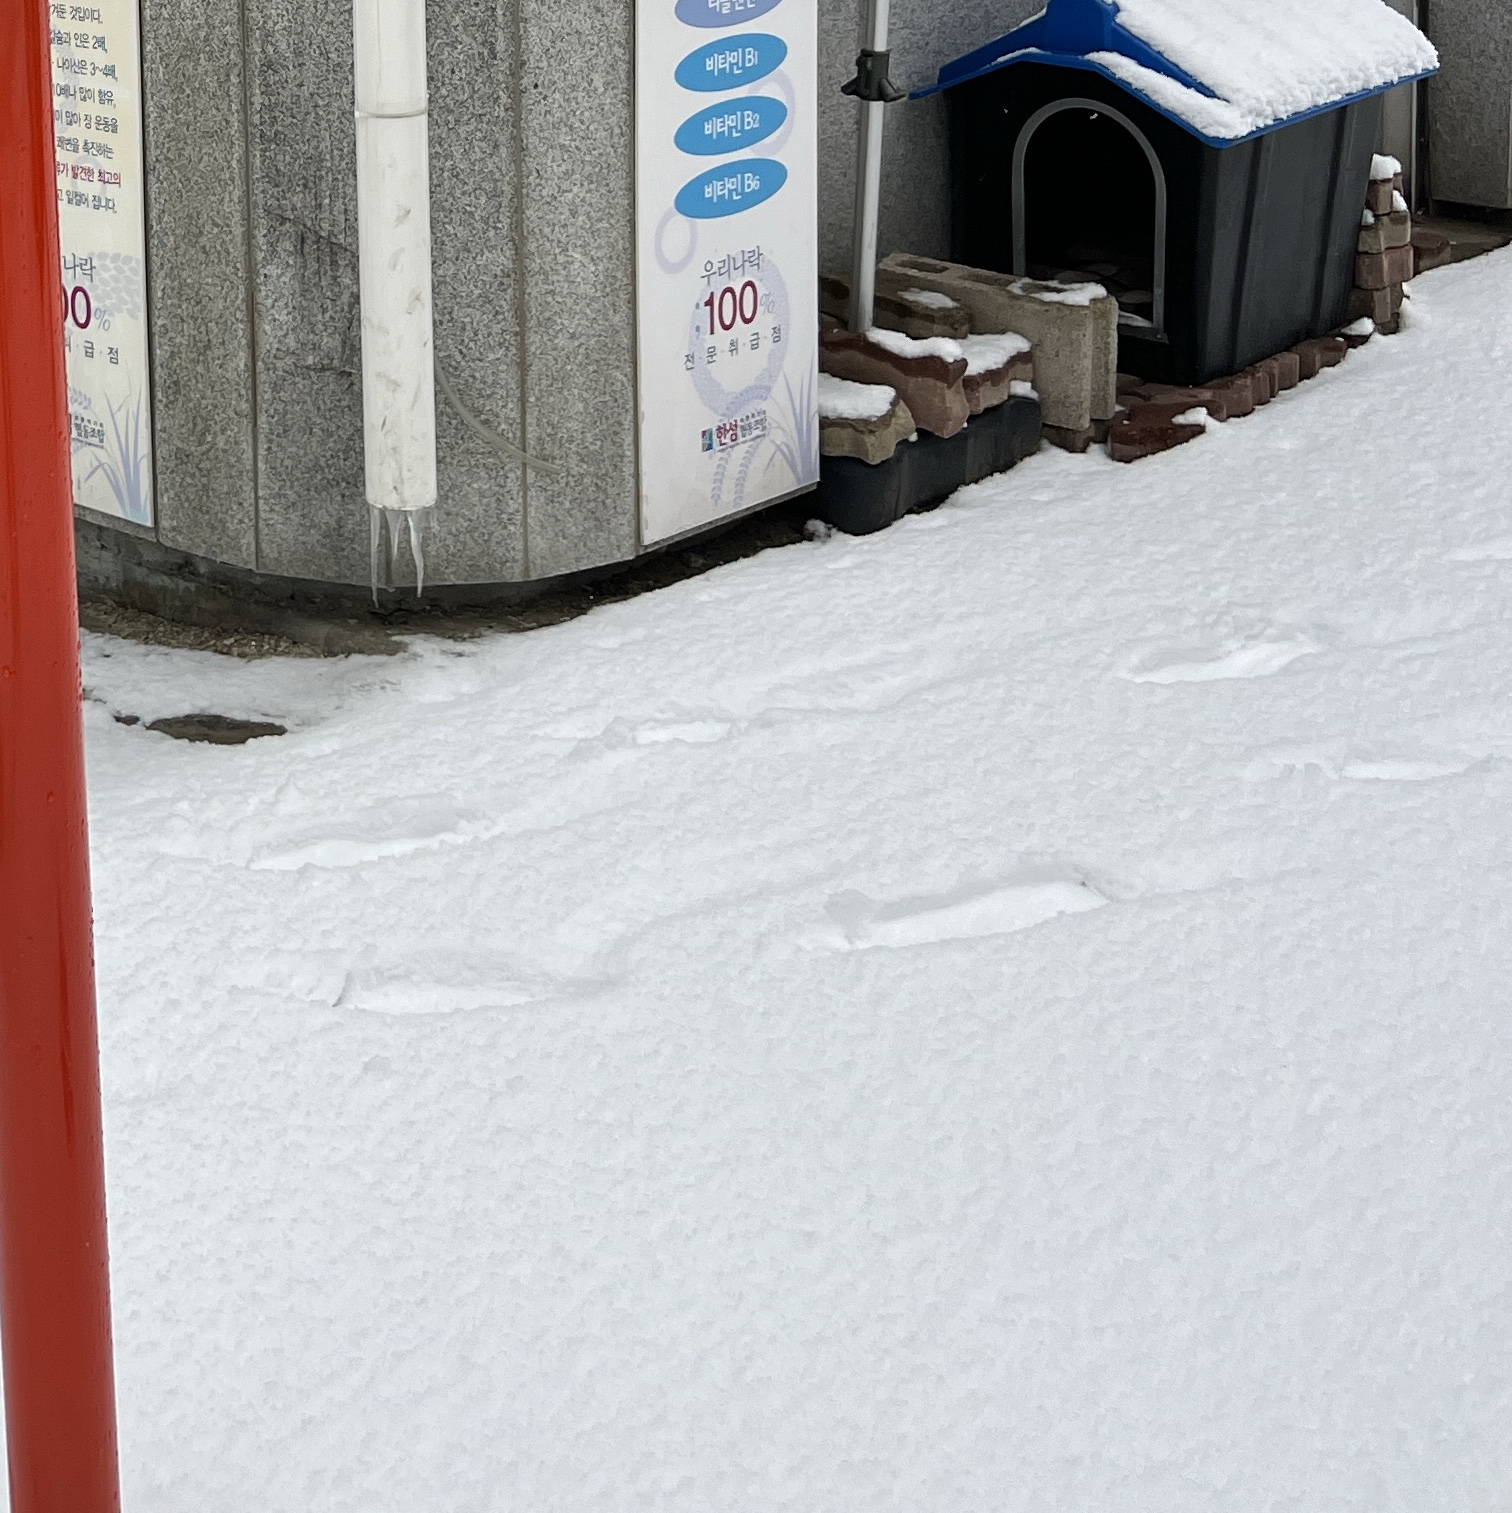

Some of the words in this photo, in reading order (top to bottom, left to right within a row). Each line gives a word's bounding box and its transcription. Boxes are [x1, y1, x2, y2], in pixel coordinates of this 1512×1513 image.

[705, 48, 743, 77] 비타민
[78, 86, 96, 104] 많이
[83, 113, 92, 130] 장
[94, 114, 119, 135] 운동을
[704, 111, 742, 140] 비타민
[743, 110, 760, 131] B2
[704, 174, 742, 203] 비타민
[743, 172, 761, 194] B6
[62, 252, 96, 284] 나락
[700, 245, 764, 286] 우리나락
[715, 418, 738, 447] 한섬
